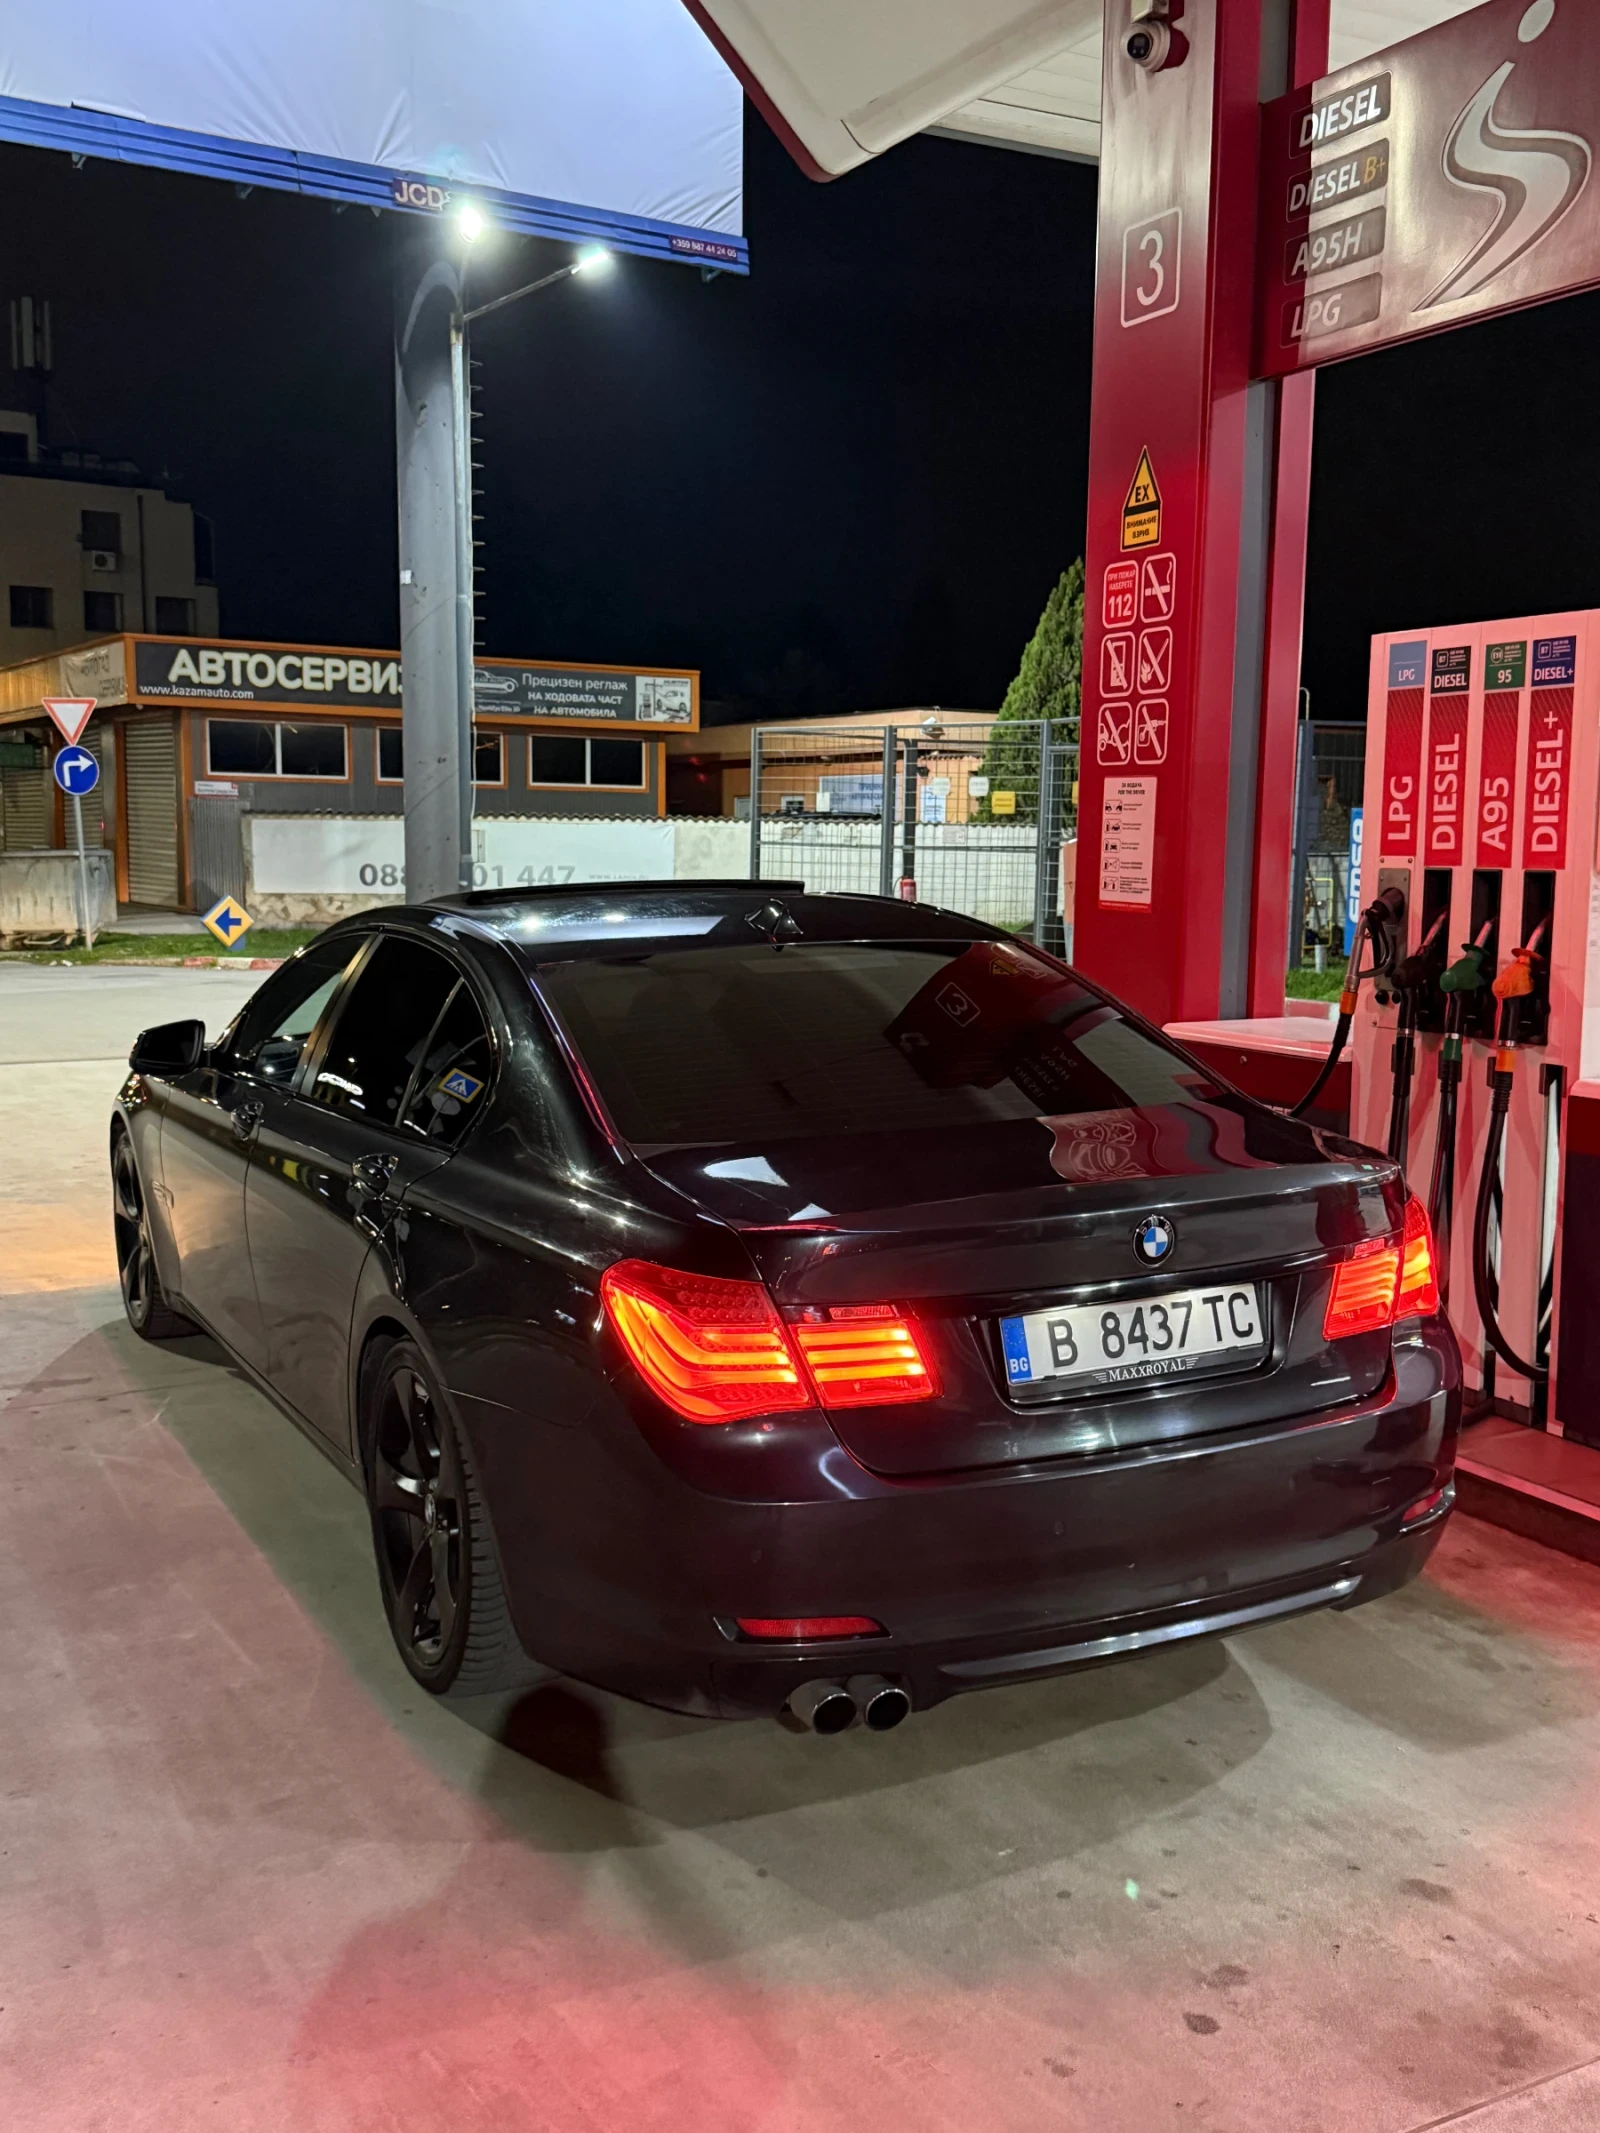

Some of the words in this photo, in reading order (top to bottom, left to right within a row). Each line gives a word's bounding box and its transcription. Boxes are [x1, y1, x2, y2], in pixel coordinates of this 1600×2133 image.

[1299, 84, 1382, 149] DIESEL
[1289, 161, 1360, 213] DIESEL
[1364, 156, 1386, 185] B+
[672, 239, 691, 249] +359
[1291, 222, 1363, 276] A95H
[1136, 229, 1164, 306] 3
[1290, 292, 1343, 338] LPG
[1135, 483, 1150, 503] EX
[1126, 516, 1157, 529] ВНИМАНИЕ
[1132, 528, 1150, 539] ВЗРИВ
[1109, 580, 1133, 590] НАБЕРЕТЕ
[1108, 593, 1133, 619] 112
[522, 672, 582, 689] Прецизен
[585, 679, 628, 692] реглаж
[1398, 668, 1415, 681] LPG
[1434, 673, 1467, 688] DIESEL
[1497, 669, 1512, 683] 95
[1534, 667, 1574, 681] DIESEL+
[139, 684, 254, 700] www.kazamauto.com
[528, 691, 543, 700] НА
[544, 692, 596, 704] ХОДОВАТА
[598, 695, 623, 705] ЧАСТ
[534, 705, 548, 715] НА
[550, 706, 617, 718] АВТОМОБИЛА
[1432, 733, 1460, 850] DIESEL
[1531, 711, 1564, 852] DIESEL+
[1388, 776, 1413, 840] LPG
[1481, 777, 1509, 851] A95
[517, 865, 576, 887] 447
[1047, 1318, 1078, 1368] B
[1101, 1300, 1192, 1359] 8437
[1202, 1292, 1254, 1342] TC
[1009, 1357, 1029, 1373] BG
[1109, 1357, 1186, 1382] MAXXROYAL
